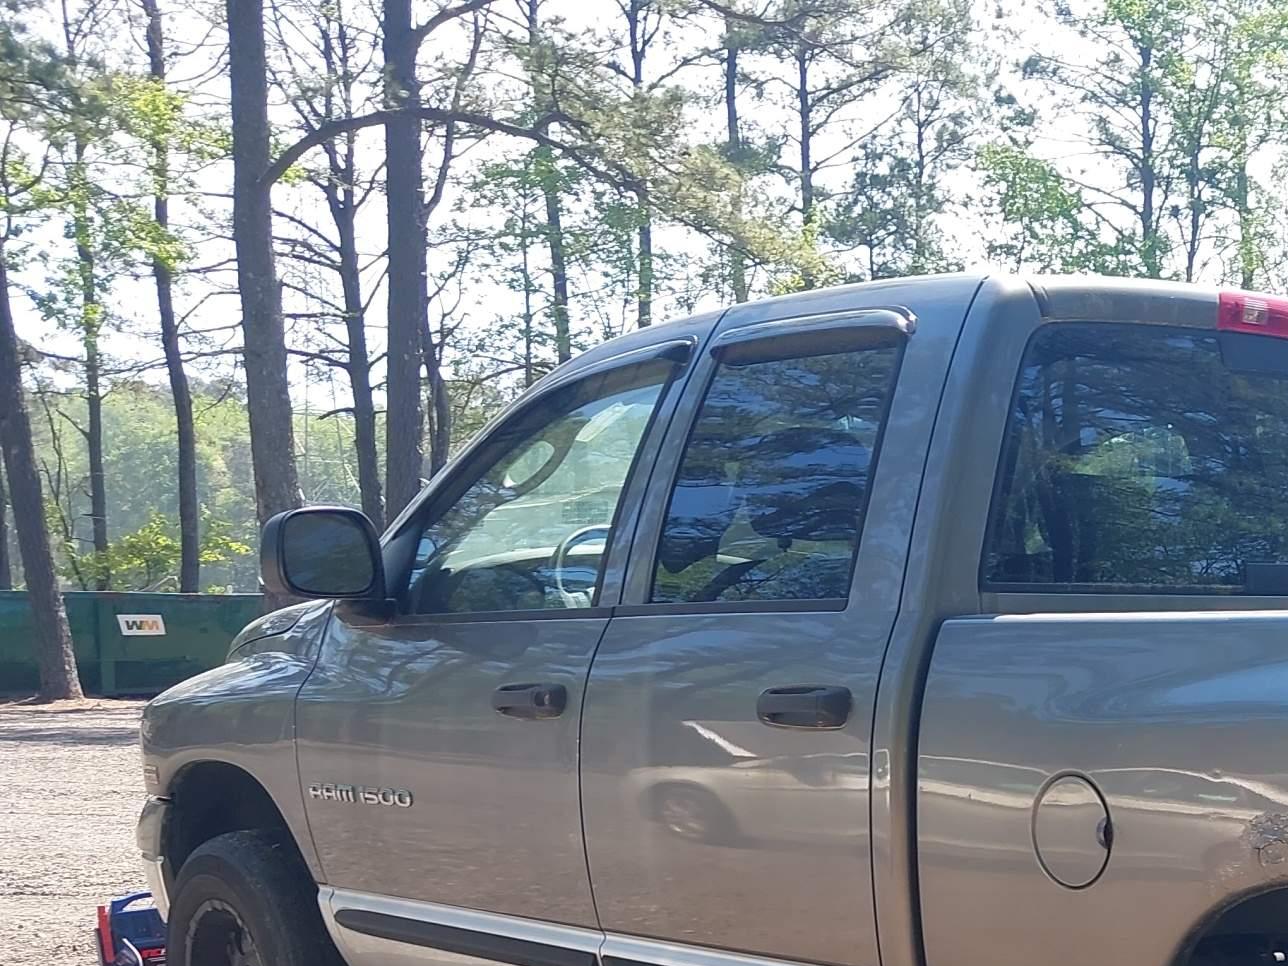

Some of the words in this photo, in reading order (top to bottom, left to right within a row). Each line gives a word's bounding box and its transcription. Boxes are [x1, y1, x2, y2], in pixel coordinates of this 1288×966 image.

[124, 620, 160, 631] WM
[309, 783, 356, 803] RAM
[359, 785, 413, 808] 1500
